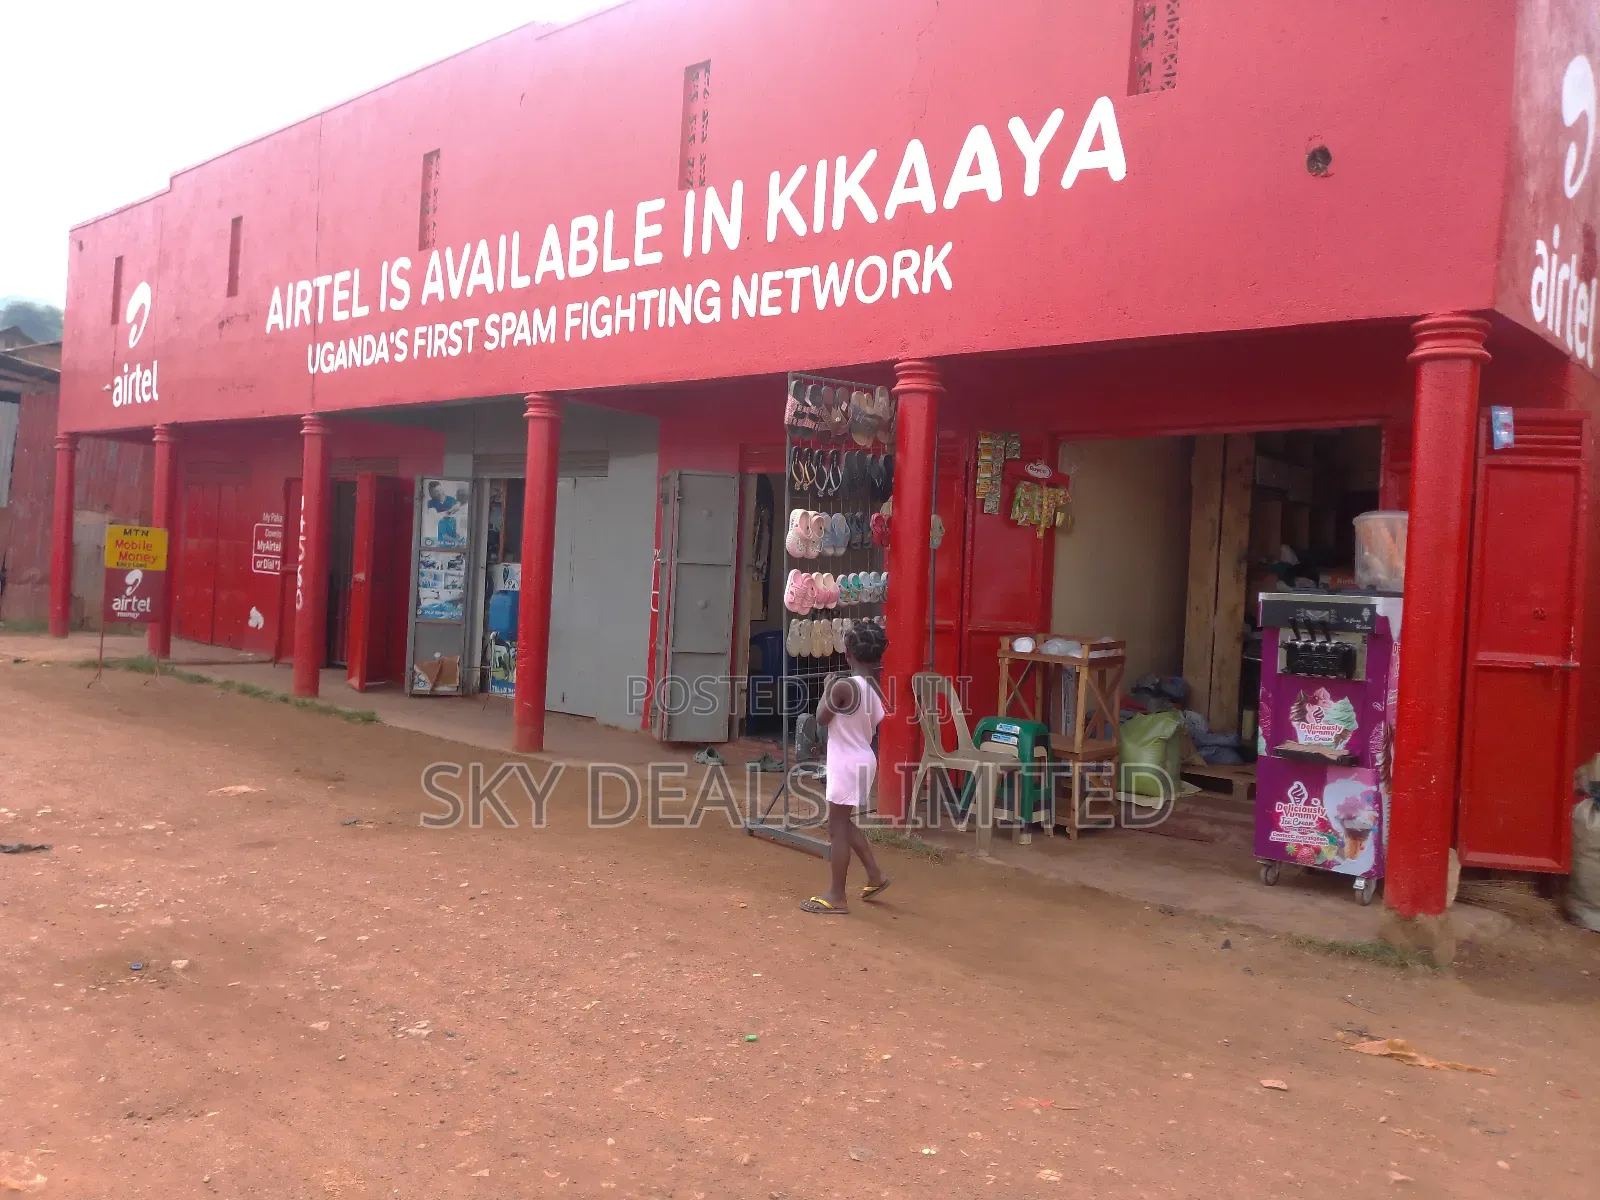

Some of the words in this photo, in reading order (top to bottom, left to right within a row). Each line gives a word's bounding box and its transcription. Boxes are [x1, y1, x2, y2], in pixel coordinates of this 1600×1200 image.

[266, 267, 370, 334] AIRTEL
[379, 256, 412, 313] IS
[421, 197, 666, 306] AVAILABLE
[683, 178, 744, 258] IN
[766, 95, 1128, 243] KIKAAYA
[1531, 224, 1597, 368] airtel
[306, 330, 408, 374] UGANDA'S
[413, 317, 480, 361] FIRST
[483, 306, 556, 351] SPAM
[565, 278, 721, 343] FIGHTING
[731, 241, 953, 320] NETWORK
[112, 360, 159, 408] airtel
[123, 528, 150, 537] MTN
[115, 539, 153, 551] Mobile
[118, 551, 158, 564] Money
[112, 595, 151, 612] airtel
[117, 611, 140, 619] money
[1300, 723, 1343, 733] Deliciously
[1307, 729, 1335, 737] Yummy
[1276, 803, 1327, 816] Deliciously
[1281, 816, 1291, 825] Ice
[1292, 817, 1315, 826] Cream
[1284, 811, 1318, 821] Yummy
